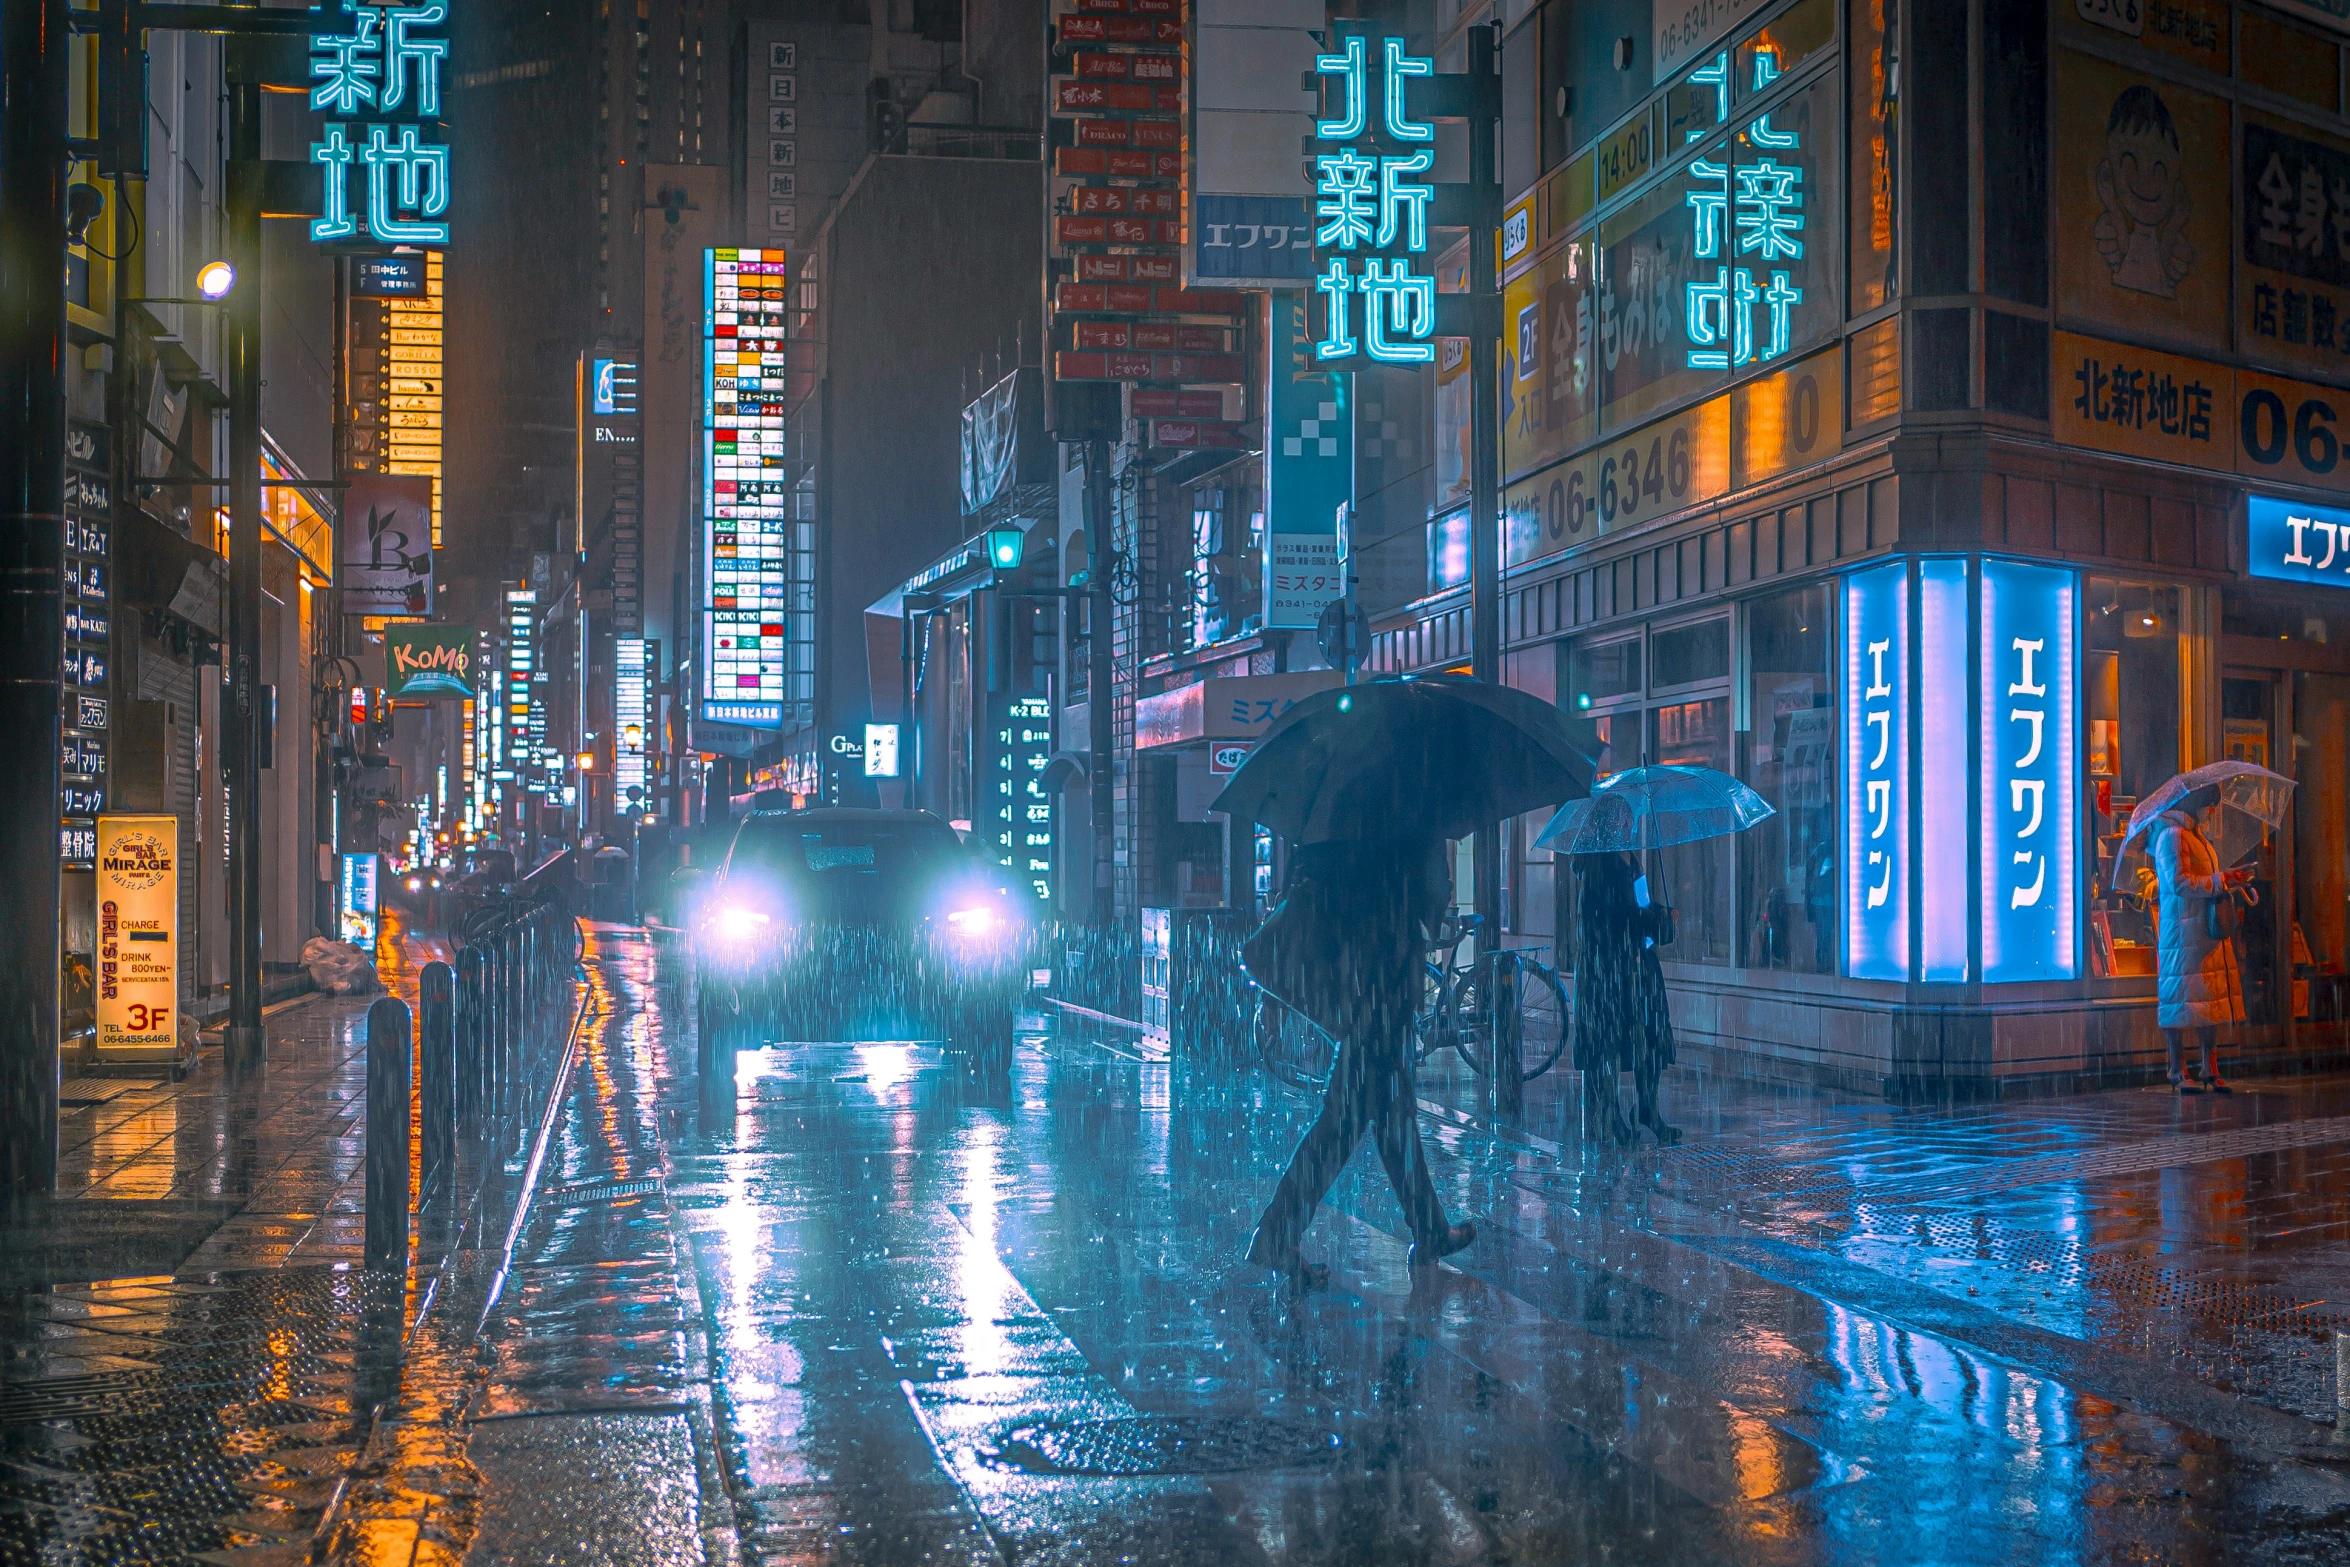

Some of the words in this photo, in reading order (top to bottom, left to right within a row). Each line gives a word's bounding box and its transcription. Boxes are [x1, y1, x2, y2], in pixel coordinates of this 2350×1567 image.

[309, 0, 449, 244] 新地
[1602, 124, 1649, 189] 14:00
[1317, 36, 1435, 362] 北新地
[371, 264, 408, 275] 田中ビル
[1522, 316, 1539, 365] 2F
[395, 351, 436, 359] GORILLA
[396, 366, 437, 374] ROSSO
[716, 379, 735, 388] KOH
[1518, 388, 1542, 439] 入口
[2074, 358, 2212, 442] 北新地店
[68, 431, 95, 460] ビル
[90, 619, 107, 634] KAZU
[81, 753, 105, 772] マリモ
[1866, 636, 1892, 910] エフワン
[2009, 636, 2047, 911] エフワン
[64, 790, 101, 812] リニック
[61, 830, 95, 857] 整骨院
[123, 844, 154, 852] GIRL'S
[102, 901, 118, 959] GIRL'S
[121, 921, 159, 930] CHARGE
[121, 953, 152, 962] DRINK
[102, 961, 118, 1000] BAR
[104, 1024, 123, 1032] TEL
[127, 1004, 169, 1031] 3F
[104, 1035, 170, 1044] 06-6455-6466
